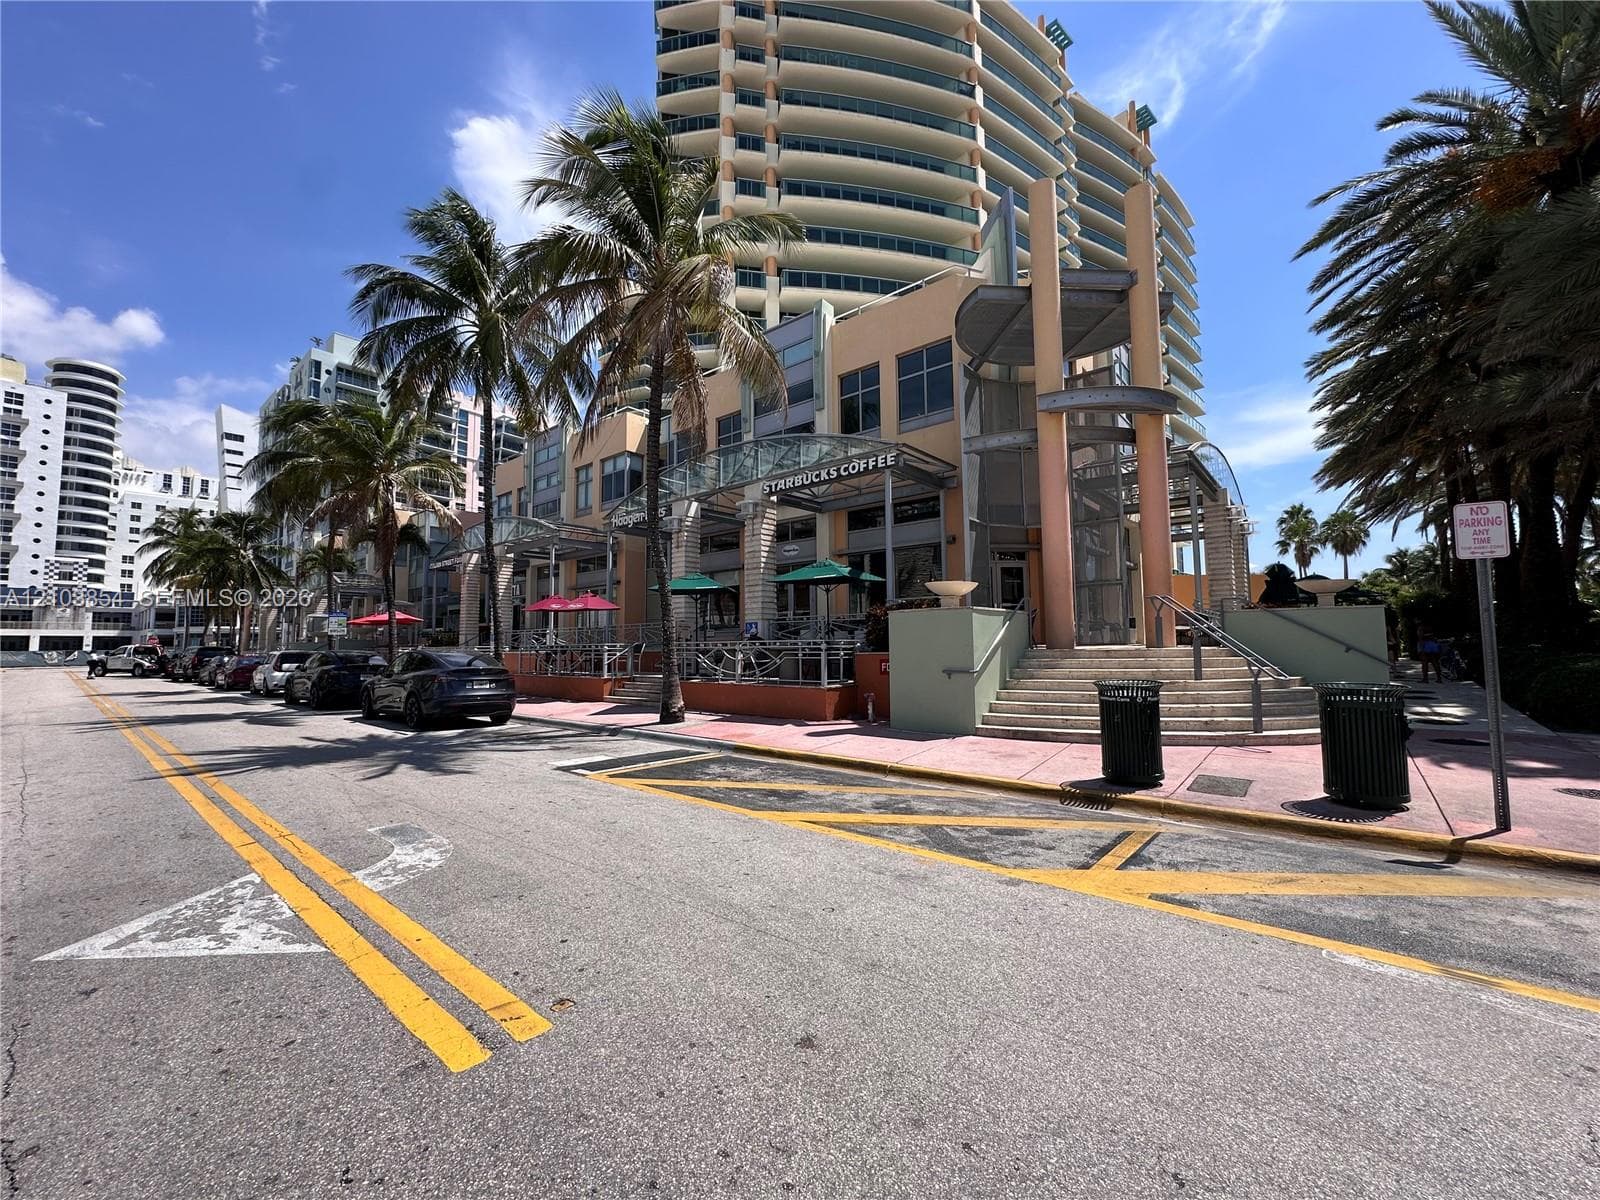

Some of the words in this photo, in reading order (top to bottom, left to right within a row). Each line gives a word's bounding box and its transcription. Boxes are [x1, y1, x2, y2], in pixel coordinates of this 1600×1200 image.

[762, 465, 838, 494] STARBUCKS
[840, 453, 897, 475] COFFEE
[1470, 506, 1489, 516] NO
[1459, 516, 1503, 528] PARKING
